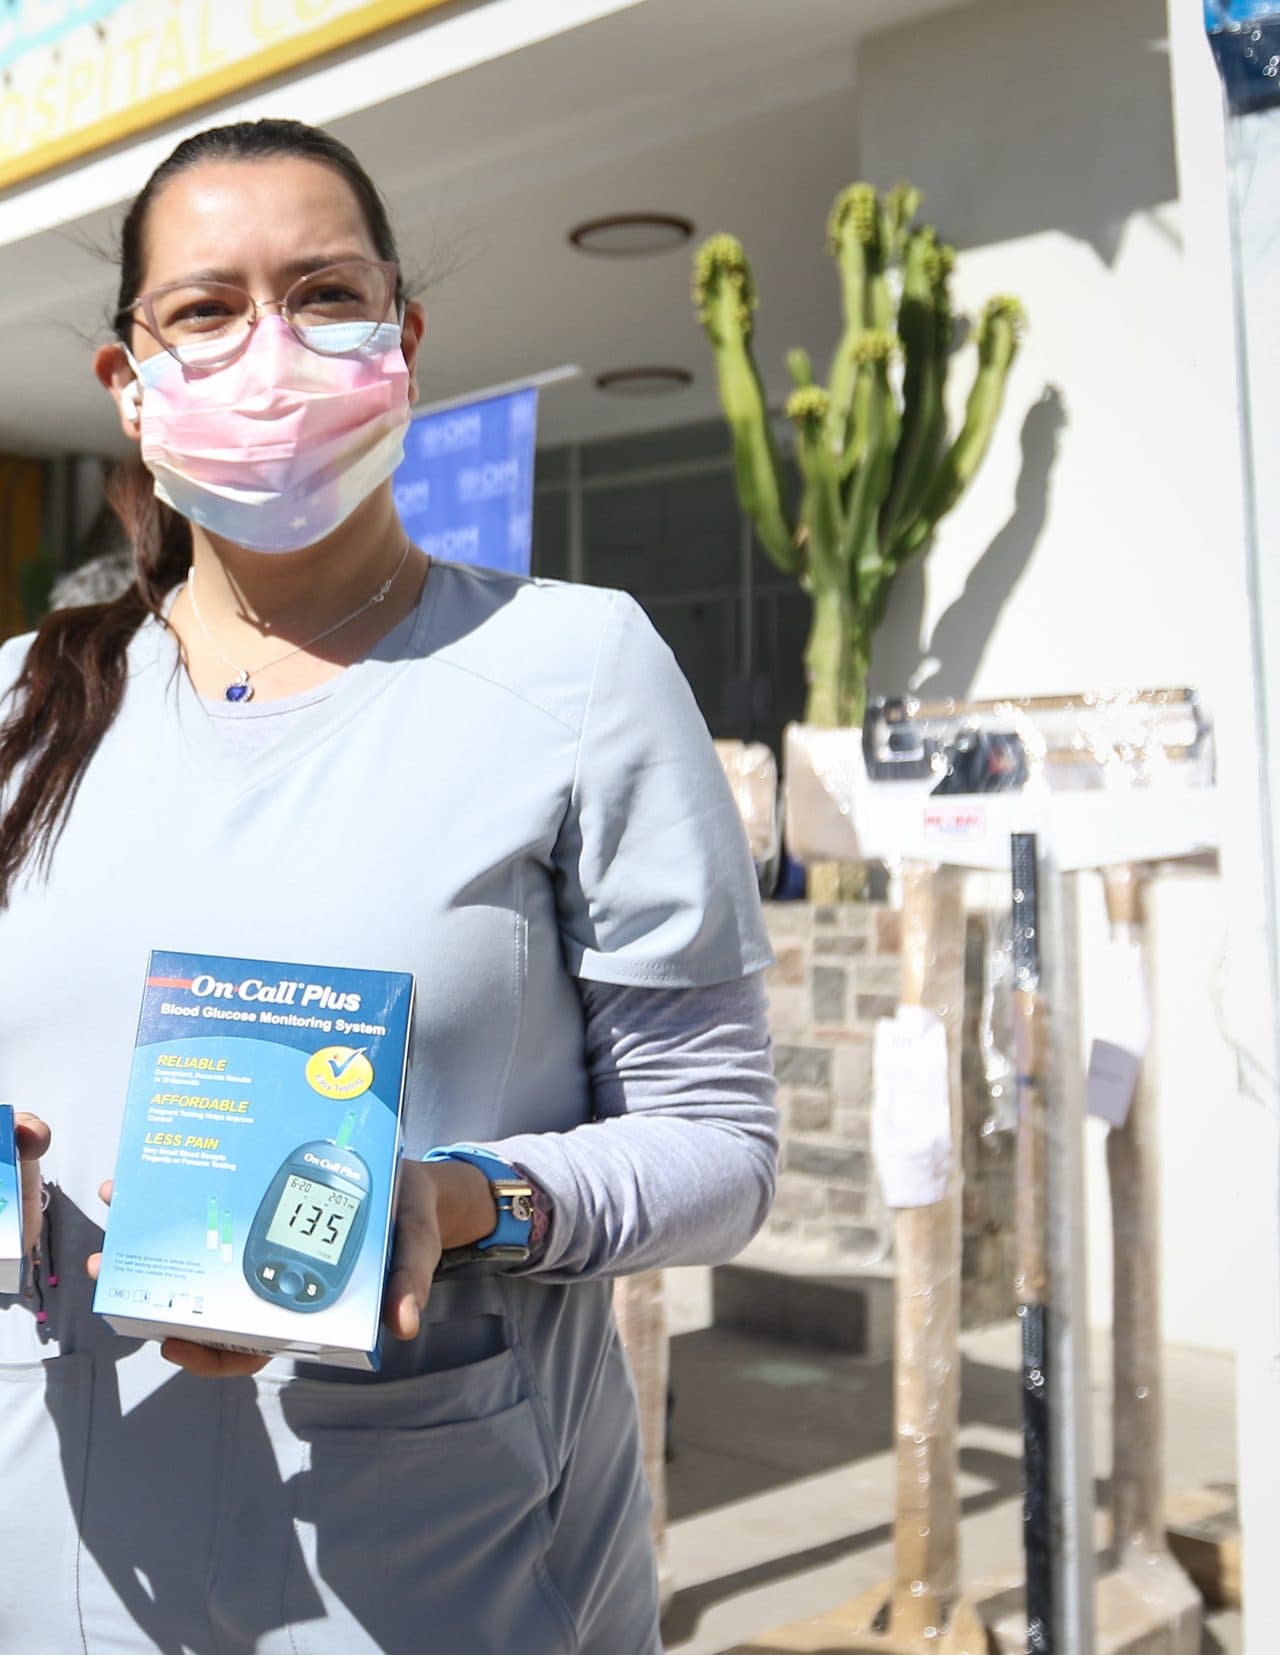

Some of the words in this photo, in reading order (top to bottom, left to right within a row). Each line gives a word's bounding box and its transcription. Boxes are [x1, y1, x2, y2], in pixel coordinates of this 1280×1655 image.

[191, 975, 233, 999] On
[238, 979, 295, 1005] Call
[301, 985, 362, 1012] Plus
[161, 1003, 200, 1017] Blood
[202, 1006, 256, 1022] Glucose
[260, 1011, 332, 1032] Monitoring
[334, 1019, 386, 1036] System
[156, 1055, 228, 1072] RELIABLE
[151, 1093, 249, 1114] AFFORDABLE
[145, 1132, 183, 1147] LESS
[185, 1136, 220, 1150] PAIN
[288, 1203, 344, 1245] 135
